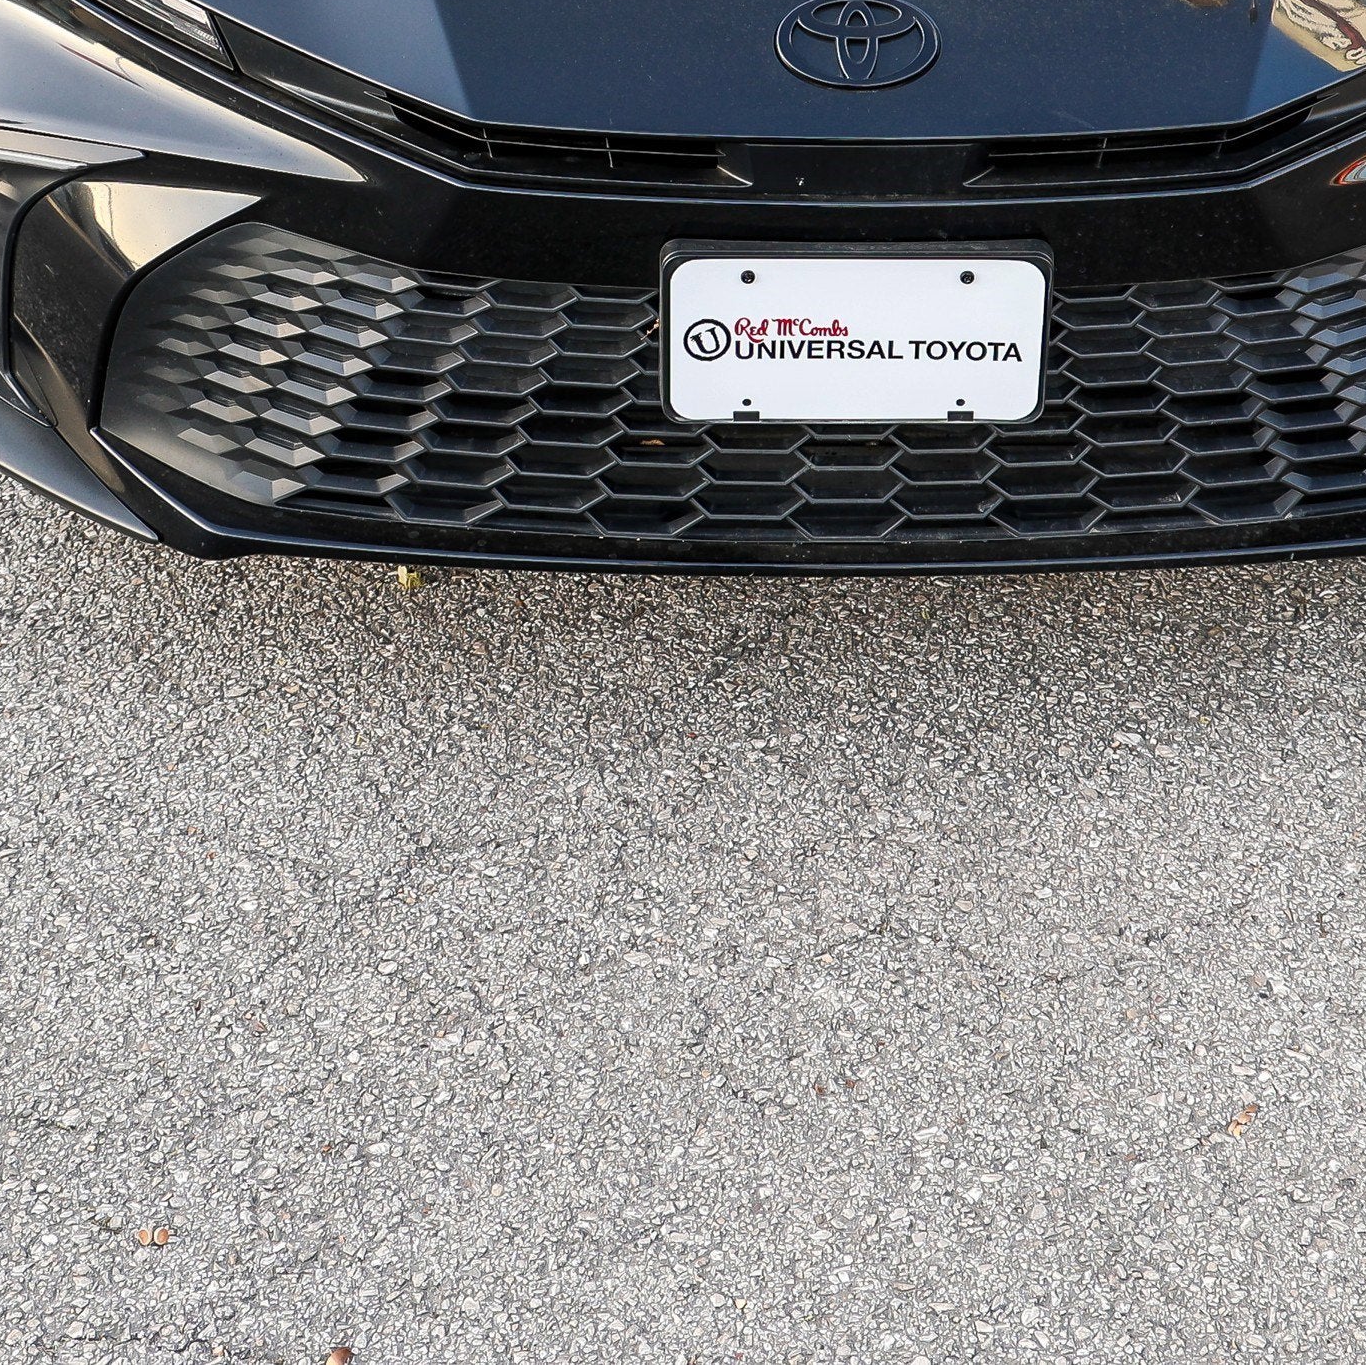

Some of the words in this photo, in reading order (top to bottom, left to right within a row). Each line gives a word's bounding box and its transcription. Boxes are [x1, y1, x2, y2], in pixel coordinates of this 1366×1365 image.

[734, 317, 769, 344] Red
[771, 318, 849, 337] McCombs
[735, 339, 904, 360] UNIVERSAL
[908, 339, 1023, 363] TOYOTA
